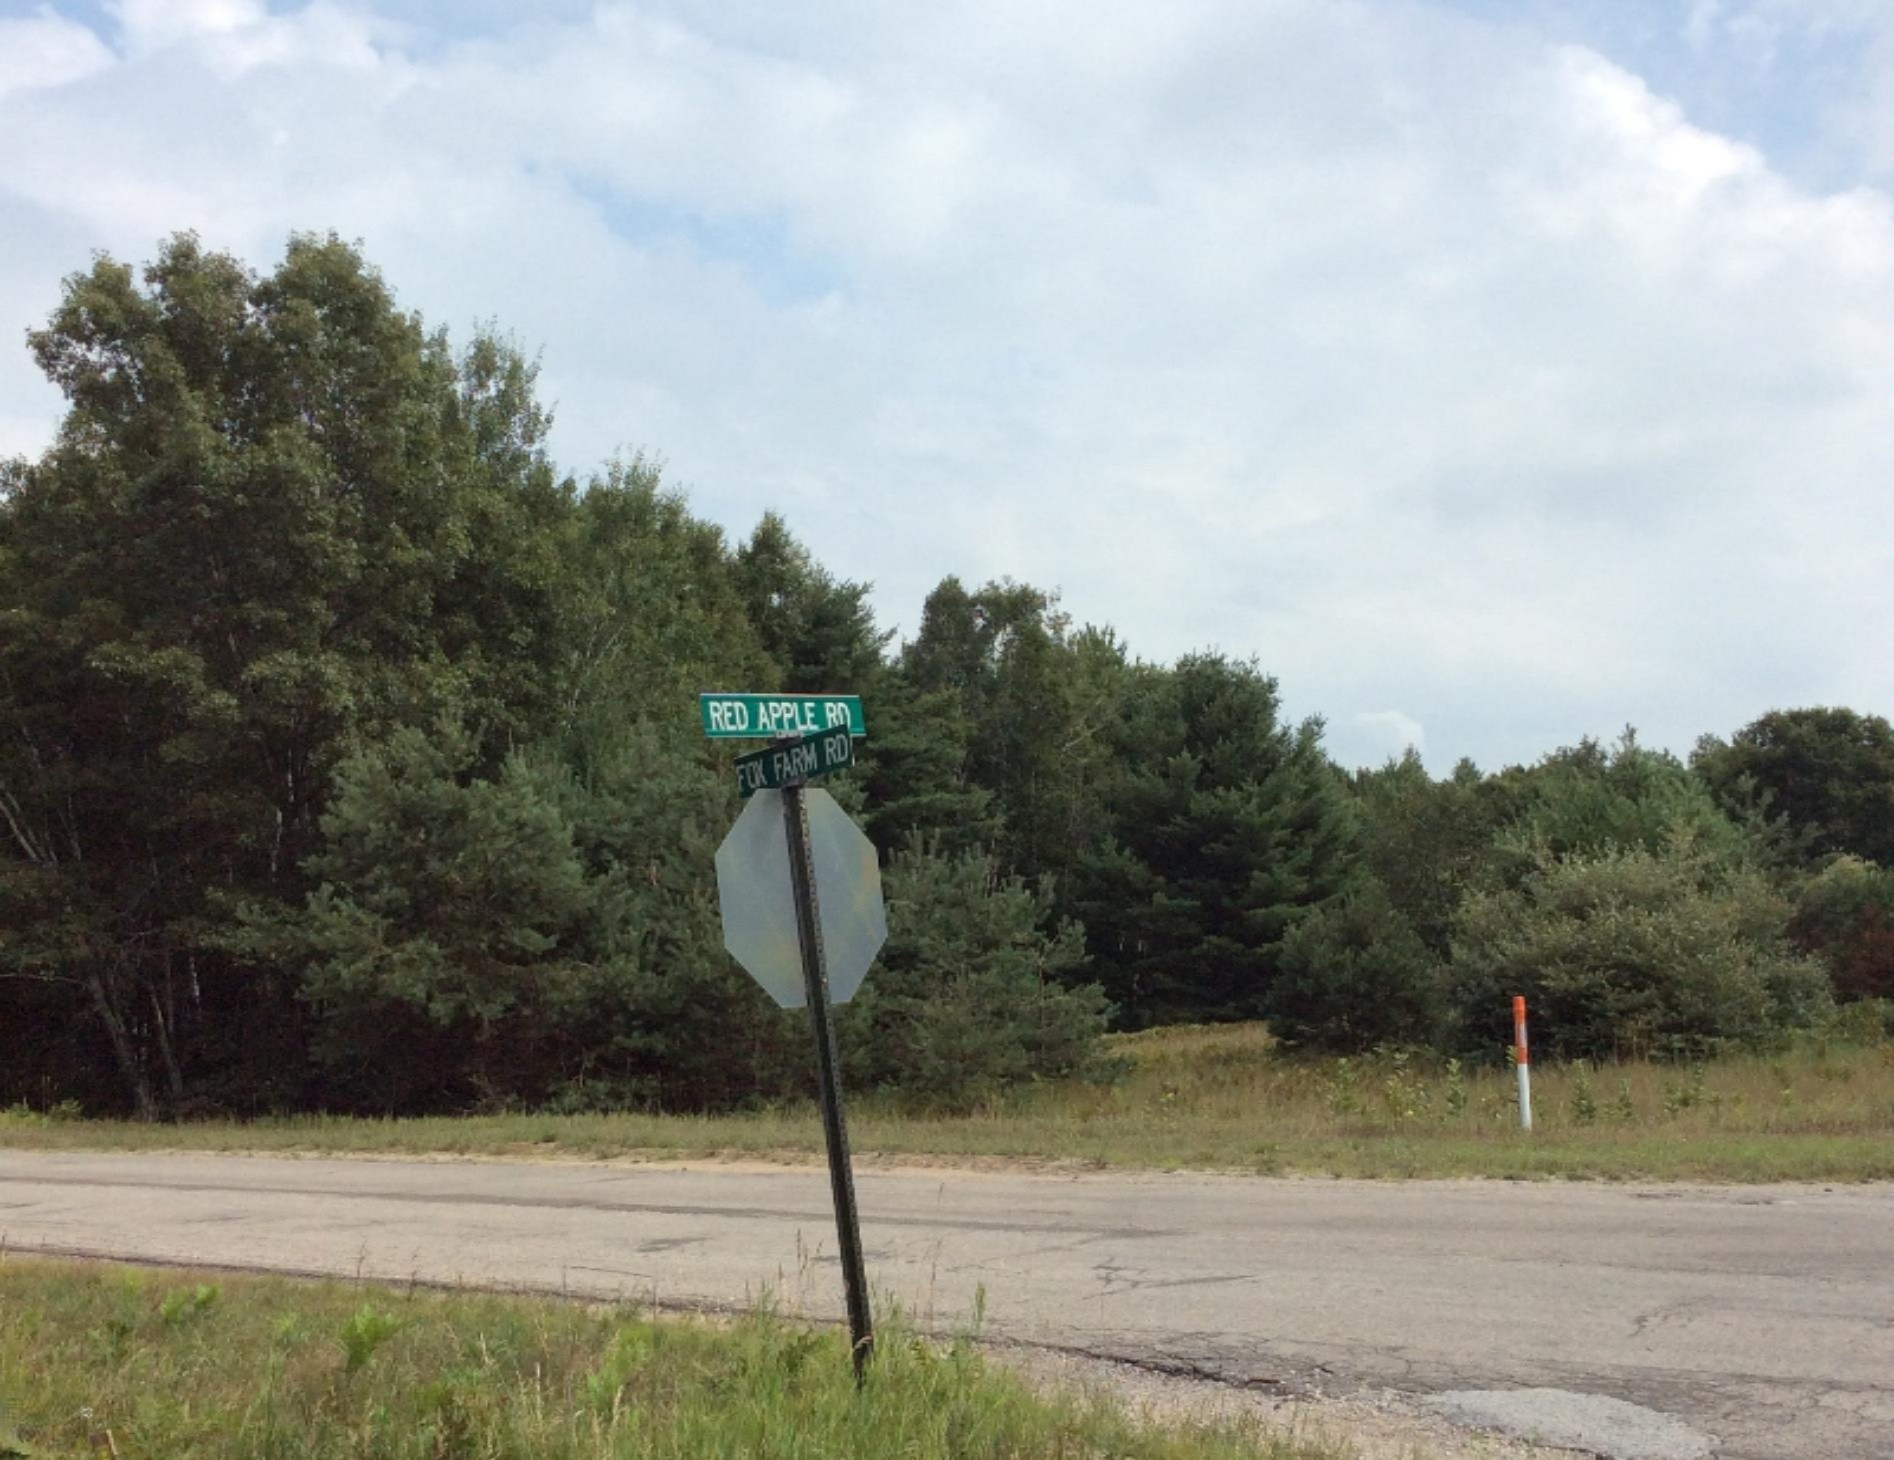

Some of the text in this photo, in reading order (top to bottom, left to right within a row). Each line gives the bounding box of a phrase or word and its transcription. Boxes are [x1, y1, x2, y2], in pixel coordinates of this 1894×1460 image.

[709, 701, 851, 731] RED APPLE RD
[736, 733, 849, 792] FOX FARM RD
